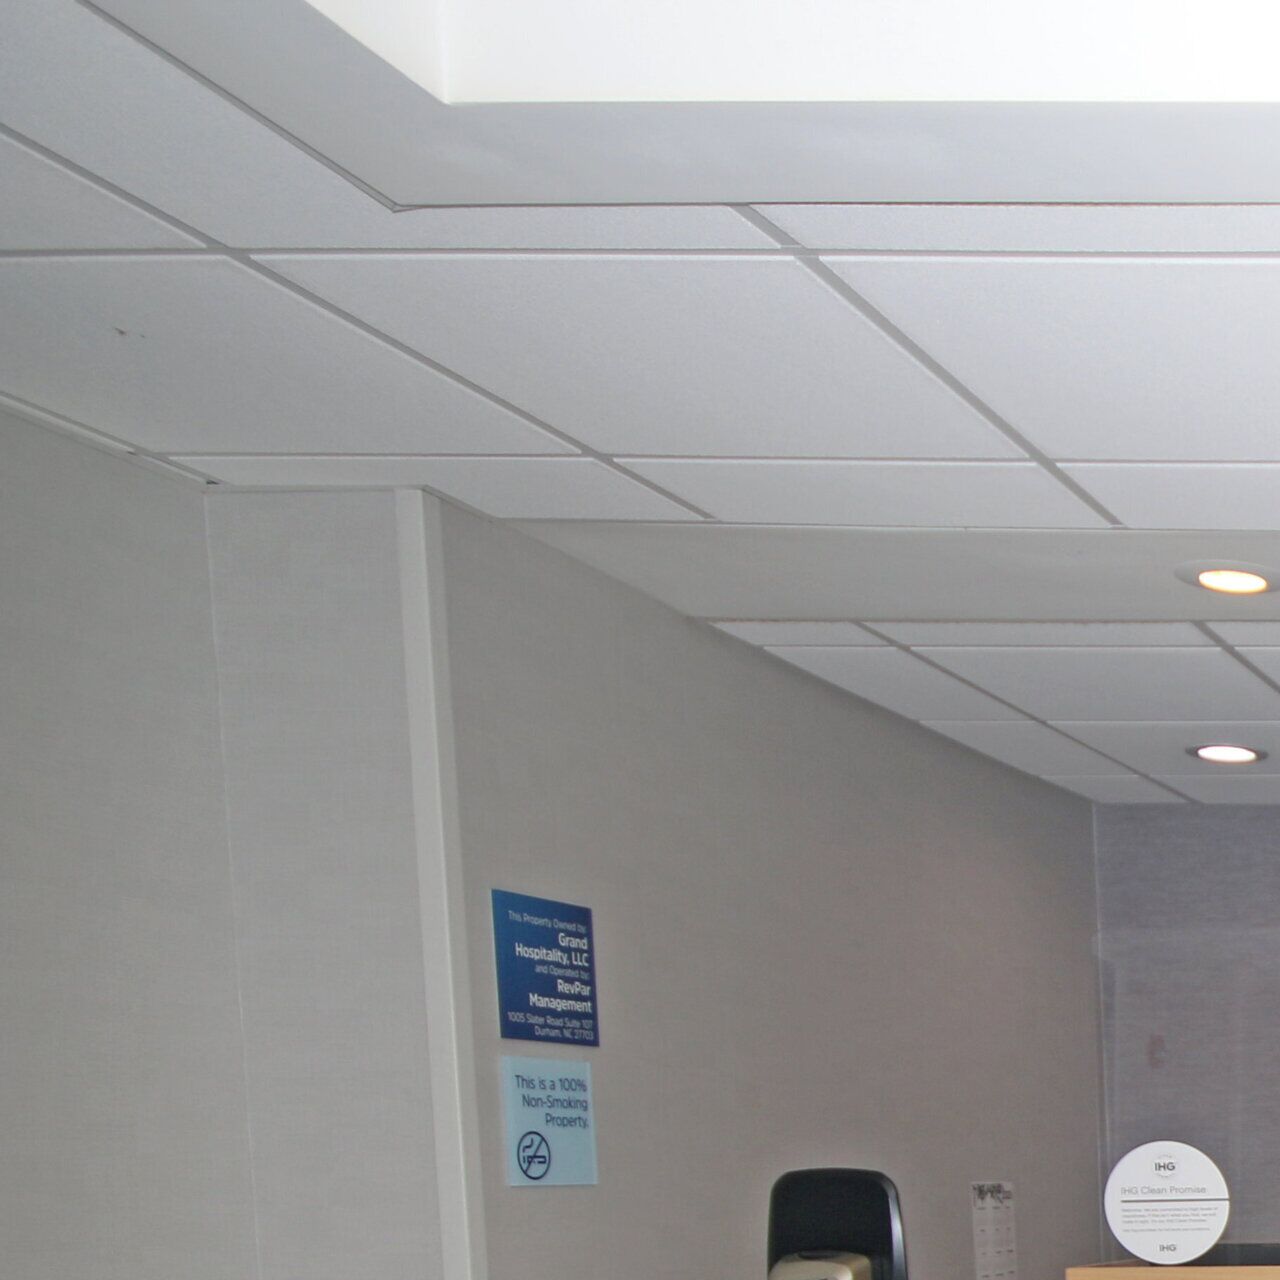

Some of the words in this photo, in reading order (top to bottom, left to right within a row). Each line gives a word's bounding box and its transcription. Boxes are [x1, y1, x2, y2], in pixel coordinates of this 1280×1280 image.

[508, 910, 522, 922] This
[523, 913, 552, 928] Property
[553, 919, 576, 931] Owned
[558, 932, 588, 949] Grand
[515, 942, 569, 966] Hospitality,
[572, 953, 589, 967] LLC
[535, 964, 548, 974] and
[549, 965, 579, 978] Operated
[557, 979, 592, 996] RevPar
[529, 992, 592, 1013] Management
[508, 1011, 525, 1023] 1005
[546, 1015, 563, 1026] Road
[565, 1017, 580, 1028] Suite
[563, 1028, 572, 1039] NC
[515, 1074, 536, 1090] This
[539, 1078, 546, 1090] is
[549, 1080, 556, 1090] a
[559, 1078, 588, 1093] 100%
[522, 1094, 588, 1112] Non-Smoking
[545, 1112, 589, 1129] Property.
[1154, 1162, 1175, 1171] IHG
[1120, 1186, 1138, 1195] IHG
[1140, 1185, 1167, 1195] Clean
[1169, 1185, 1206, 1194] Promise
[1159, 1244, 1177, 1252] IHG
